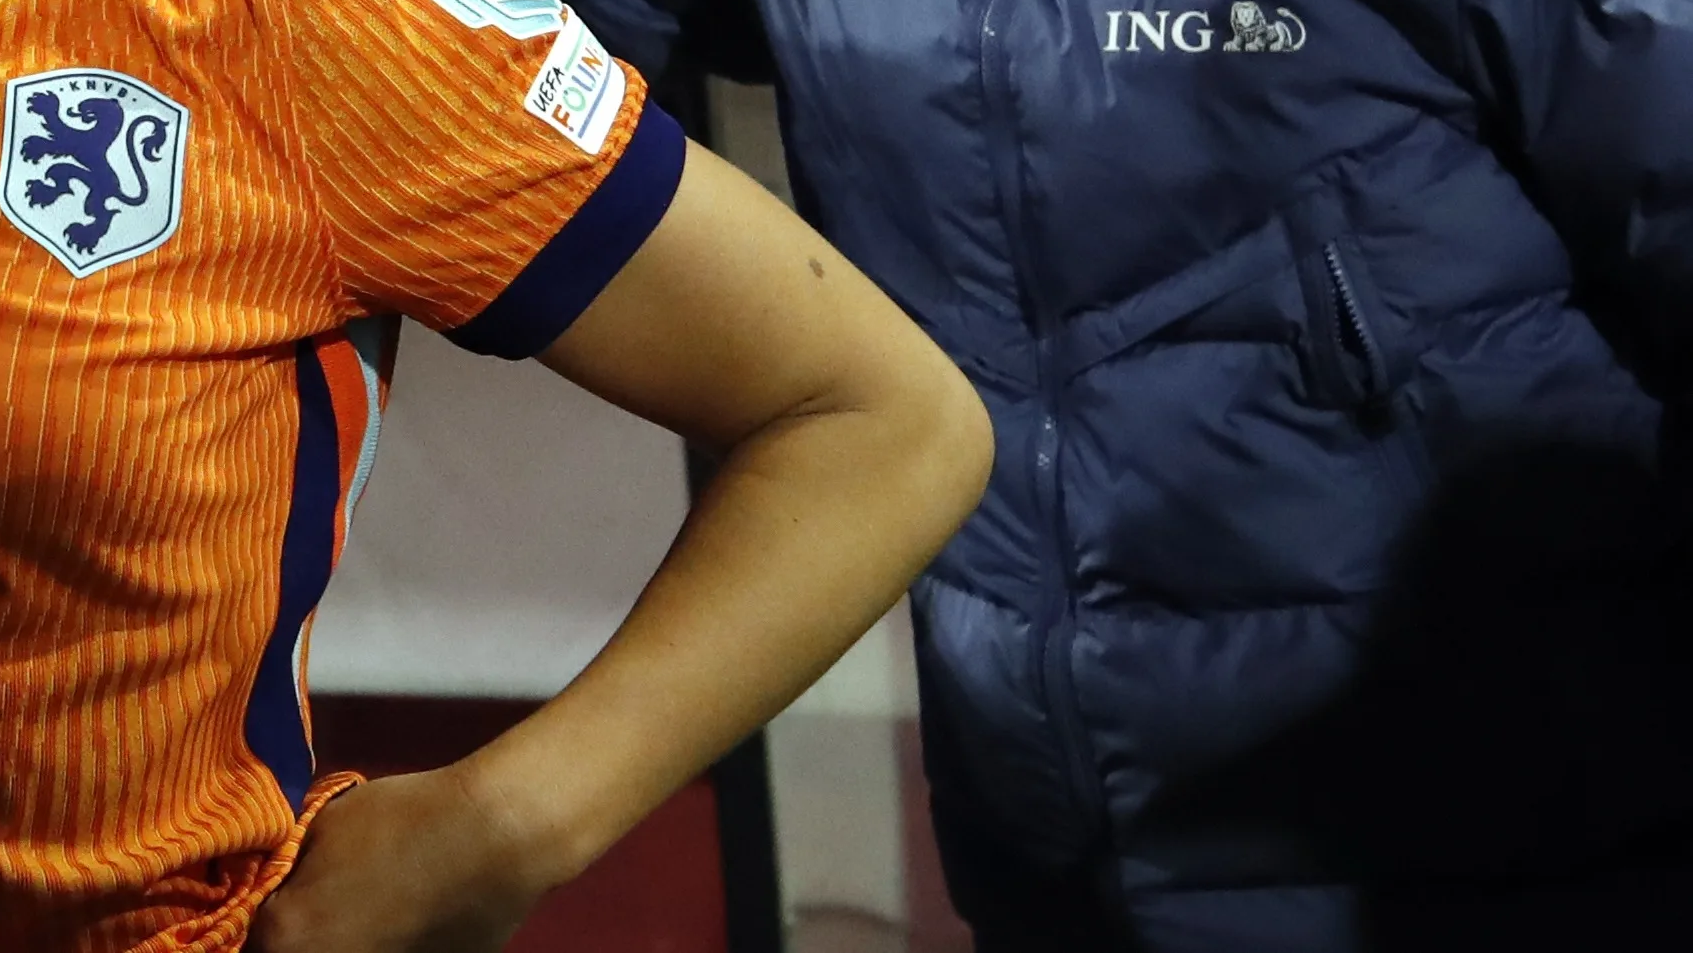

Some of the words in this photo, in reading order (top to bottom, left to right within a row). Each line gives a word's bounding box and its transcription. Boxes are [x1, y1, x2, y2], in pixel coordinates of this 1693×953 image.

[1103, 10, 1214, 53] ING
[69, 79, 128, 98] KNVB
[532, 66, 565, 113] UEFA
